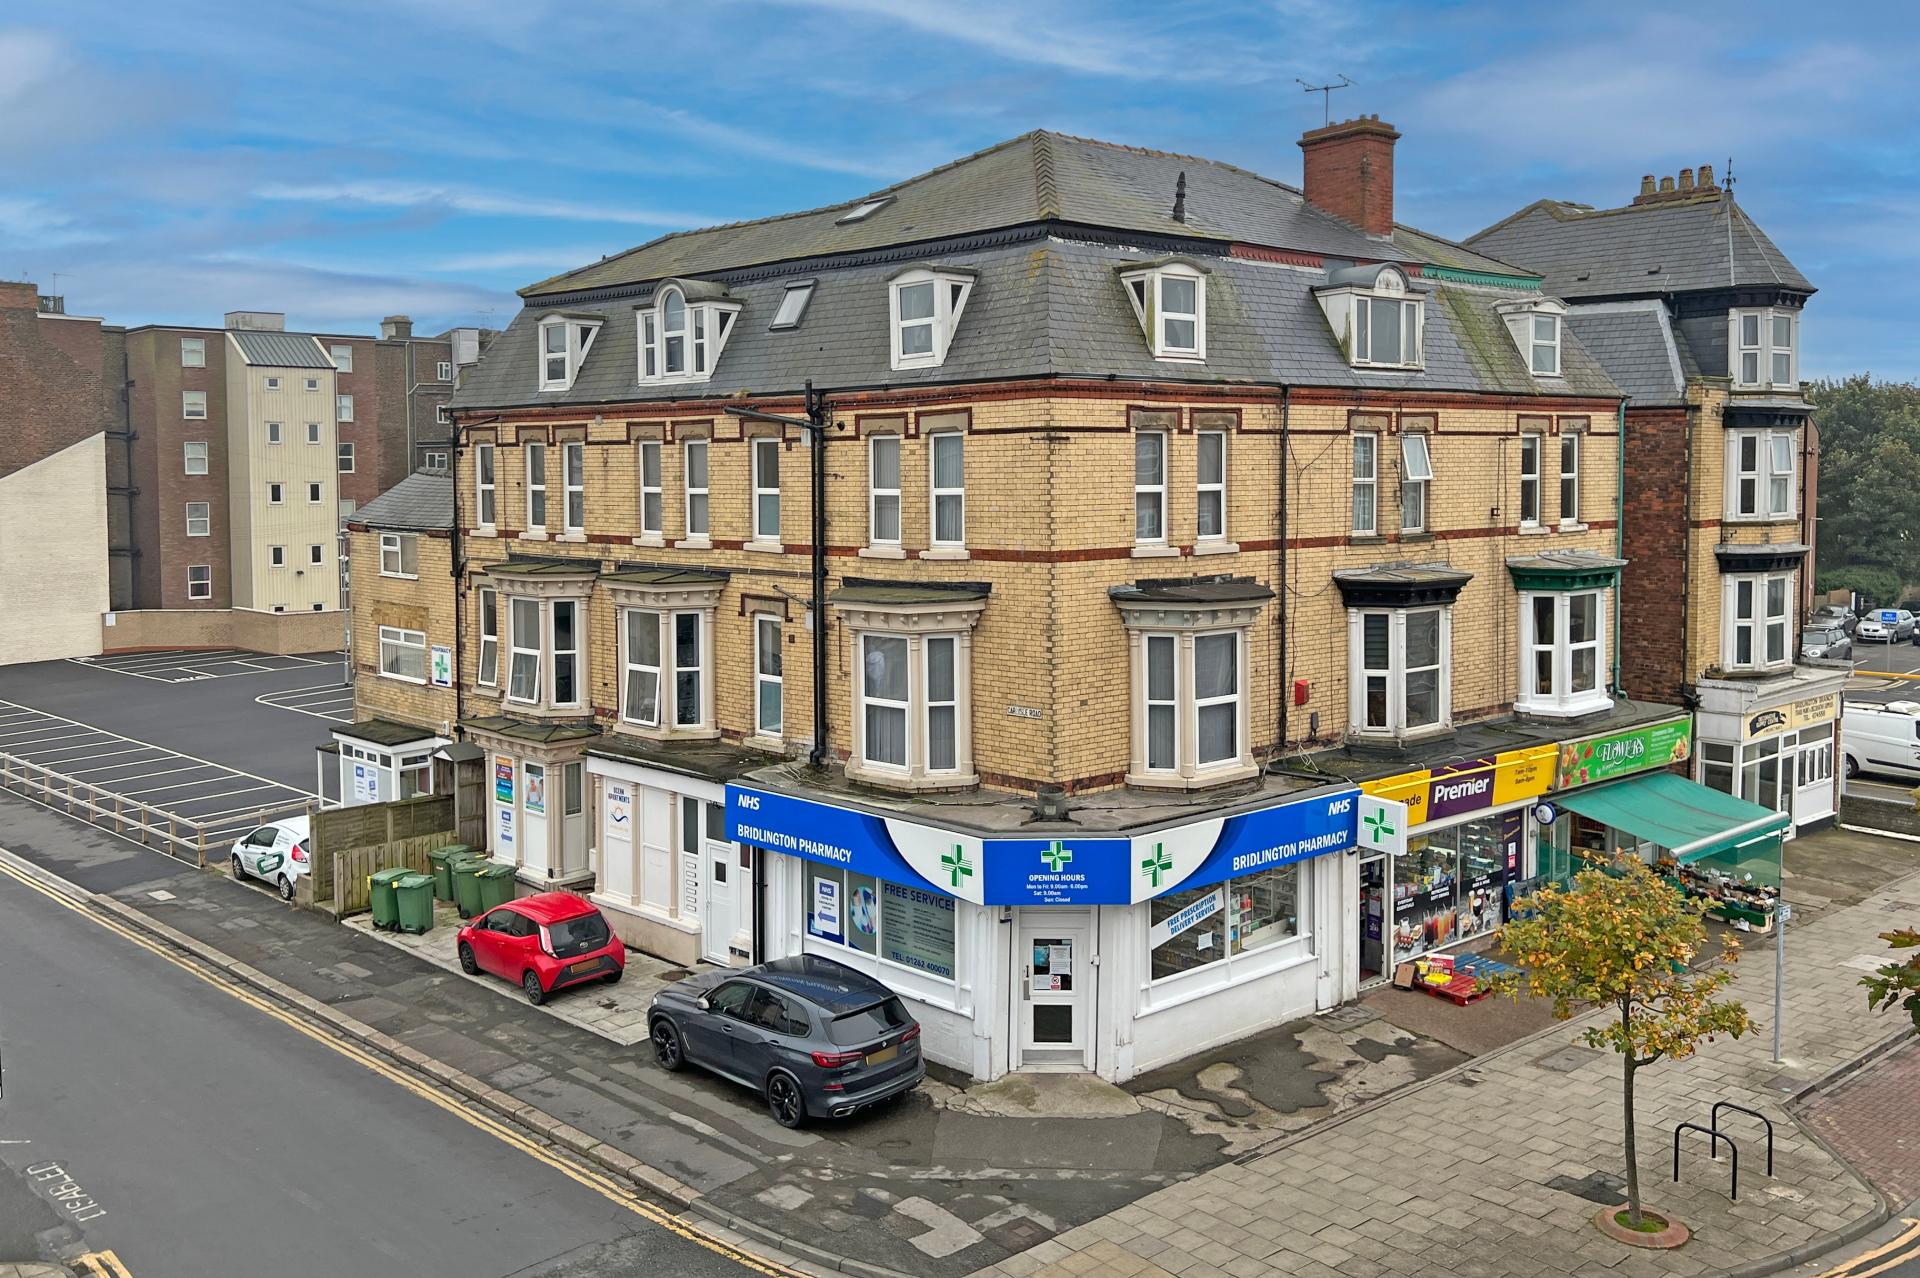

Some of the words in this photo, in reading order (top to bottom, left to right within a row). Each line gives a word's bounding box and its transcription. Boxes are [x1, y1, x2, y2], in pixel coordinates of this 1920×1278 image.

[1596, 737, 1645, 765] FLOWERS
[737, 794, 760, 811] NHS
[1434, 777, 1490, 804] Premier
[1327, 799, 1351, 817] NHS
[737, 824, 798, 850] BRIDLINGTON
[799, 838, 852, 863] PHARMACY
[1233, 843, 1297, 871] BRIDLINGTON
[1298, 830, 1348, 854] PHARMACY
[884, 883, 908, 899] FREE
[910, 890, 955, 912] SERVICES
[1167, 915, 1180, 928] FREE
[1180, 894, 1217, 920] PRESCRIPTION
[1170, 915, 1195, 935] DELIVERY
[1195, 903, 1216, 921] SERVICE
